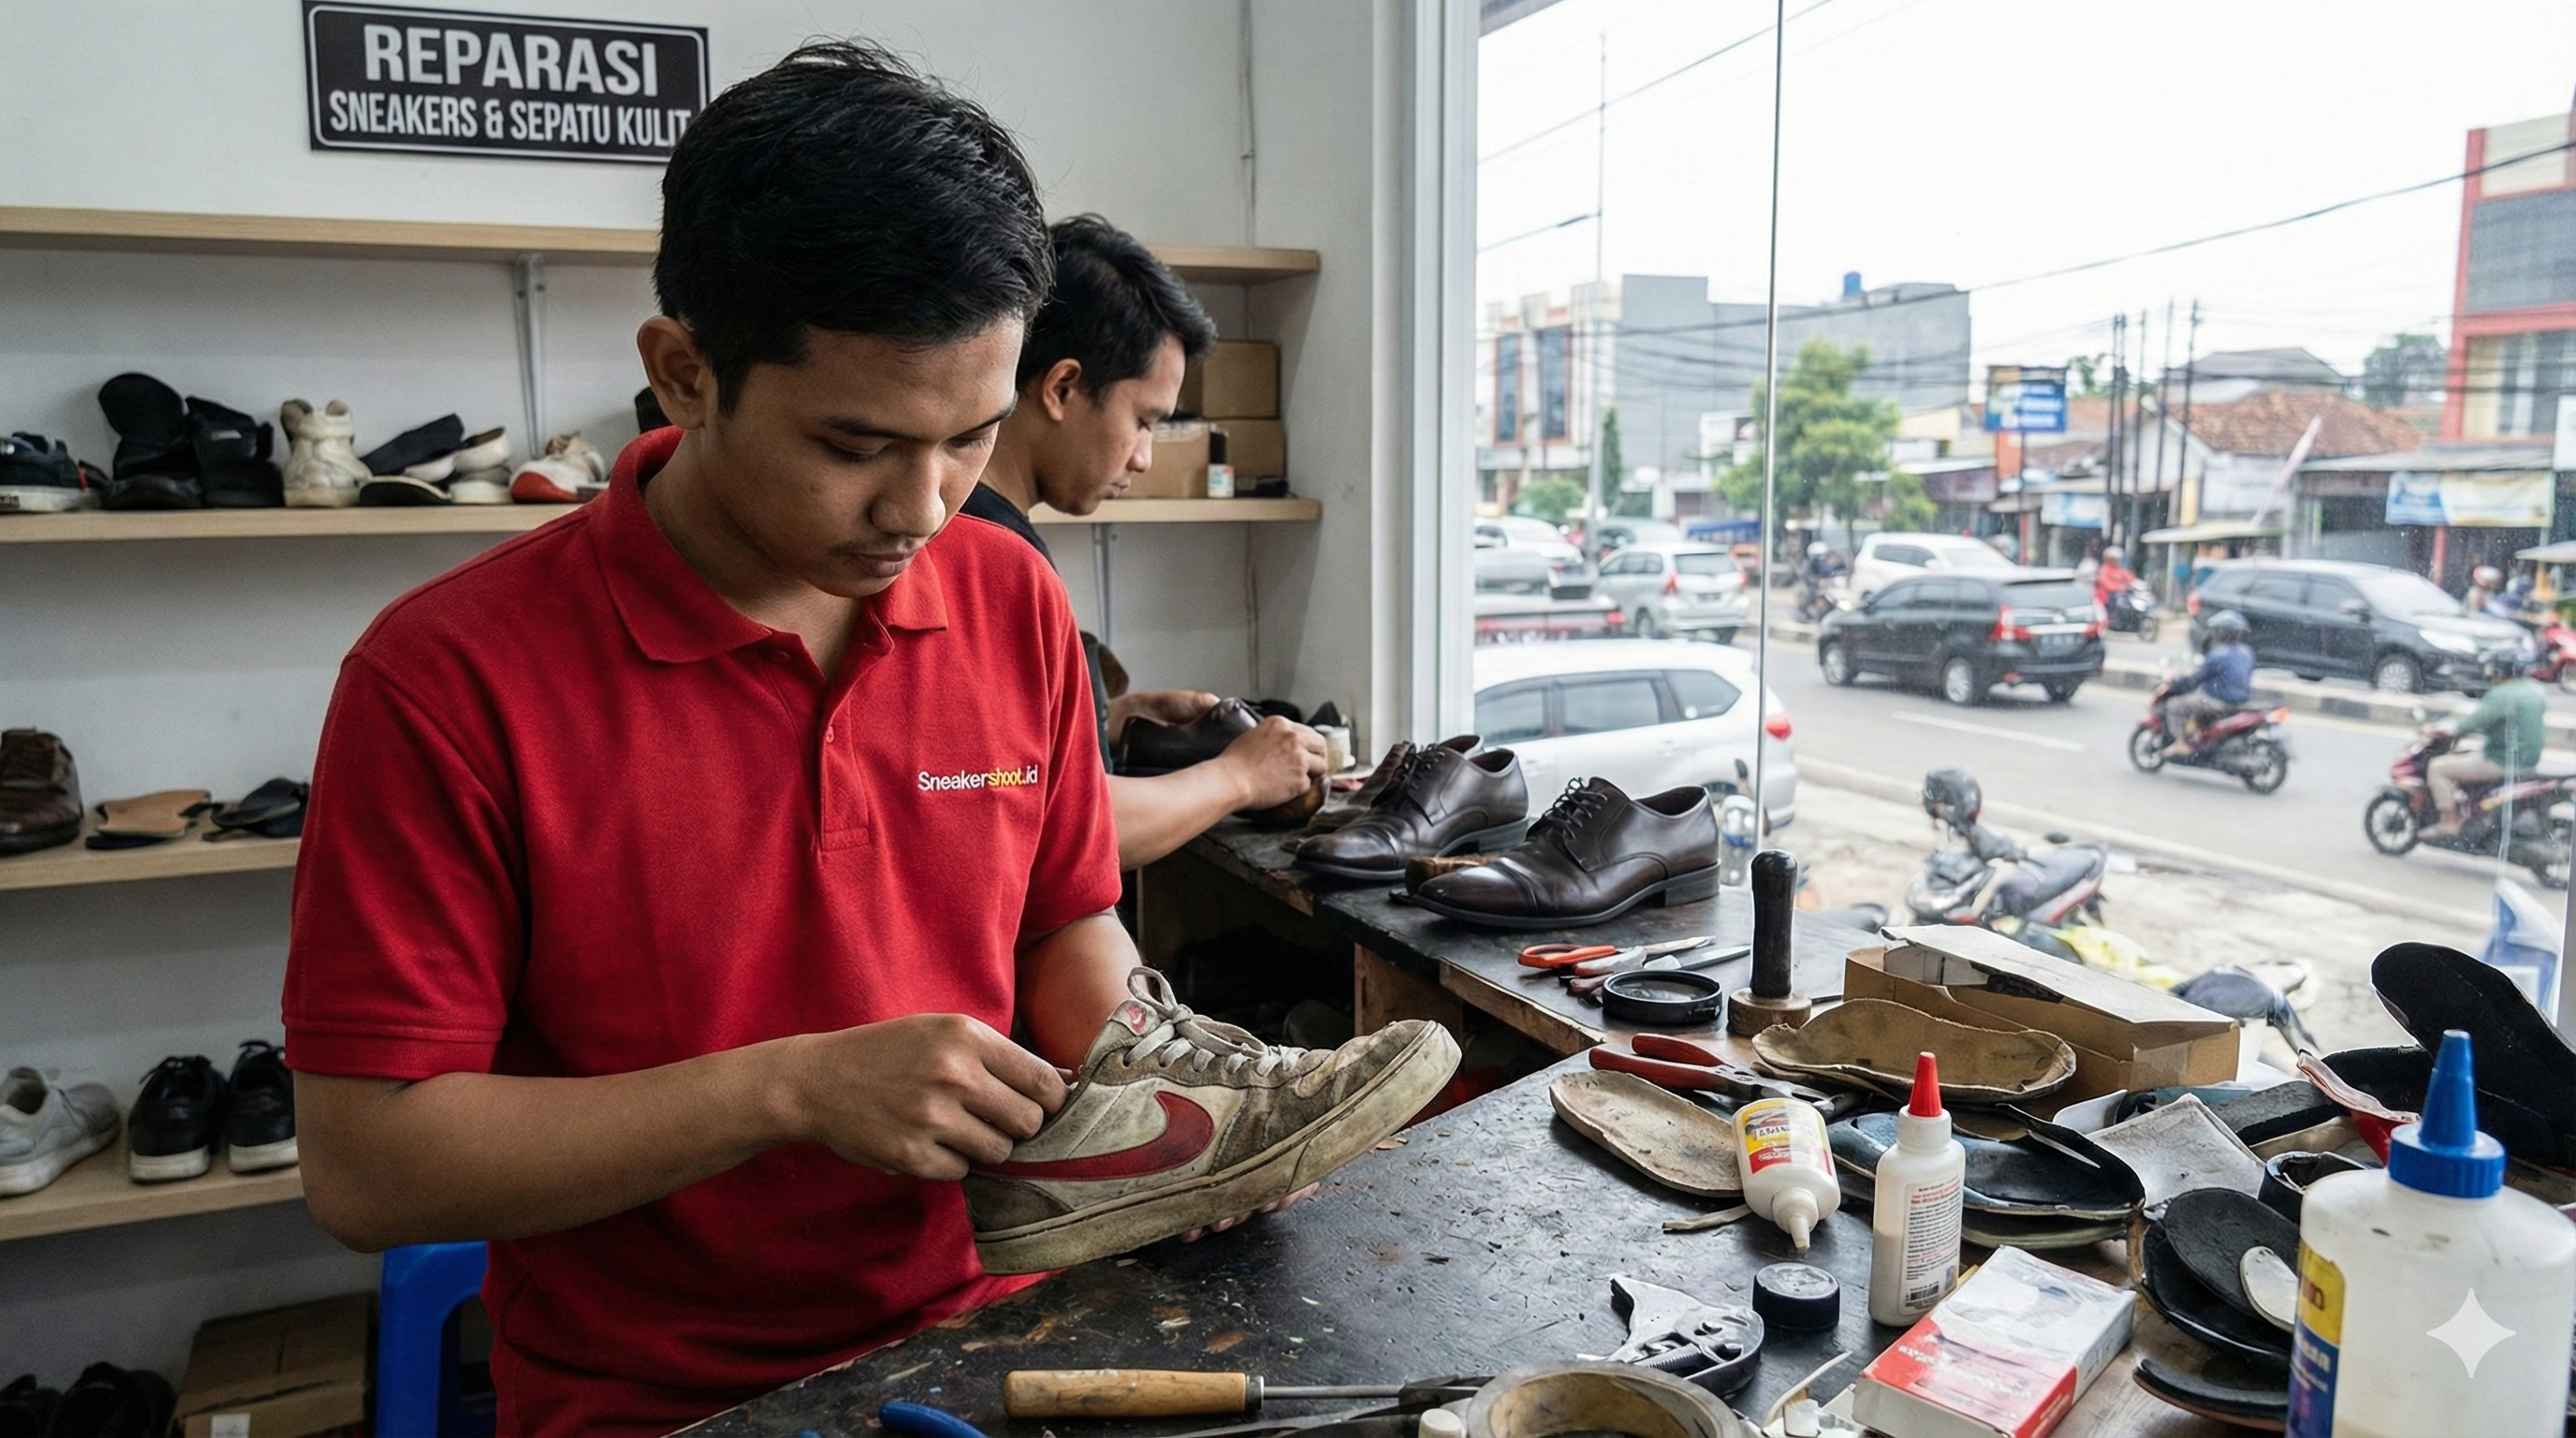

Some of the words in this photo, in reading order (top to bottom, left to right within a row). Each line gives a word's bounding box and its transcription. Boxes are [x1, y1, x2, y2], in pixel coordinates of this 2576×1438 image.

[365, 25, 657, 96] REPARASI
[329, 91, 477, 138] SNEAKERS
[485, 100, 505, 139] &
[510, 100, 611, 146] SEPATU
[618, 107, 691, 147] KULIT
[917, 764, 1038, 791] Sneakershoot.id
